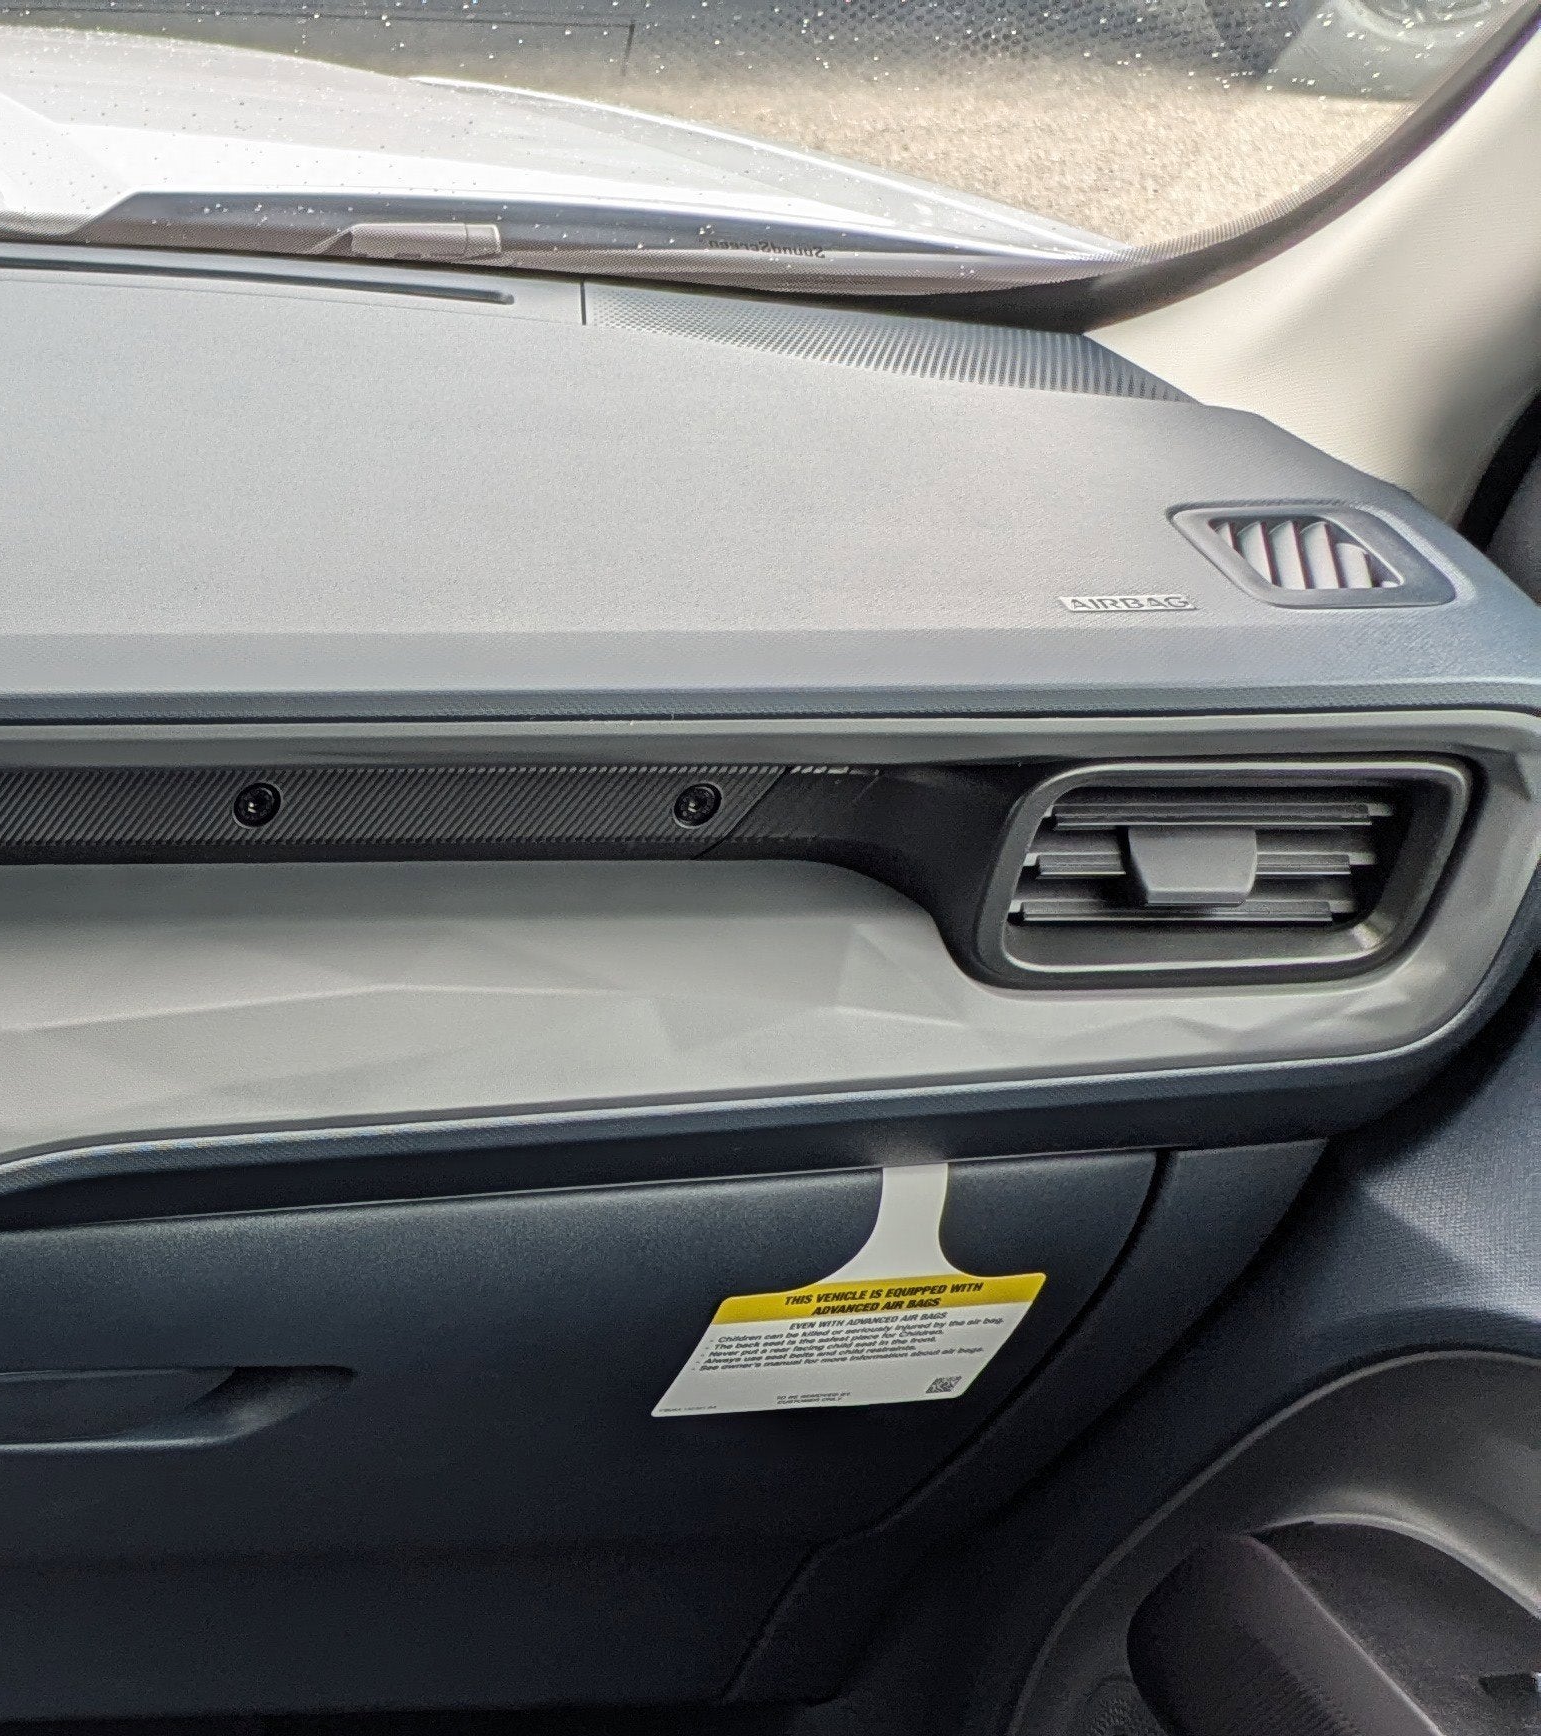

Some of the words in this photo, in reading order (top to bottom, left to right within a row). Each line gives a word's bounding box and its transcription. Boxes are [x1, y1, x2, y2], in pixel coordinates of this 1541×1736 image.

[1070, 597, 1191, 611] AIRBAG
[784, 1294, 813, 1306] THIS
[816, 1289, 868, 1303] VEHICLE
[869, 1289, 883, 1299] IS
[885, 1285, 948, 1298] EQUIPPED
[950, 1282, 984, 1293] WITH
[811, 1302, 880, 1316] ADVANCED
[882, 1300, 904, 1310] AIR
[906, 1298, 941, 1309] BAGS
[789, 1320, 816, 1330] EVEN
[818, 1318, 844, 1328] WITH
[847, 1315, 898, 1327] ADVANCED
[900, 1313, 919, 1322] AIR
[920, 1311, 948, 1321] BAGS
[718, 1334, 762, 1343] Children
